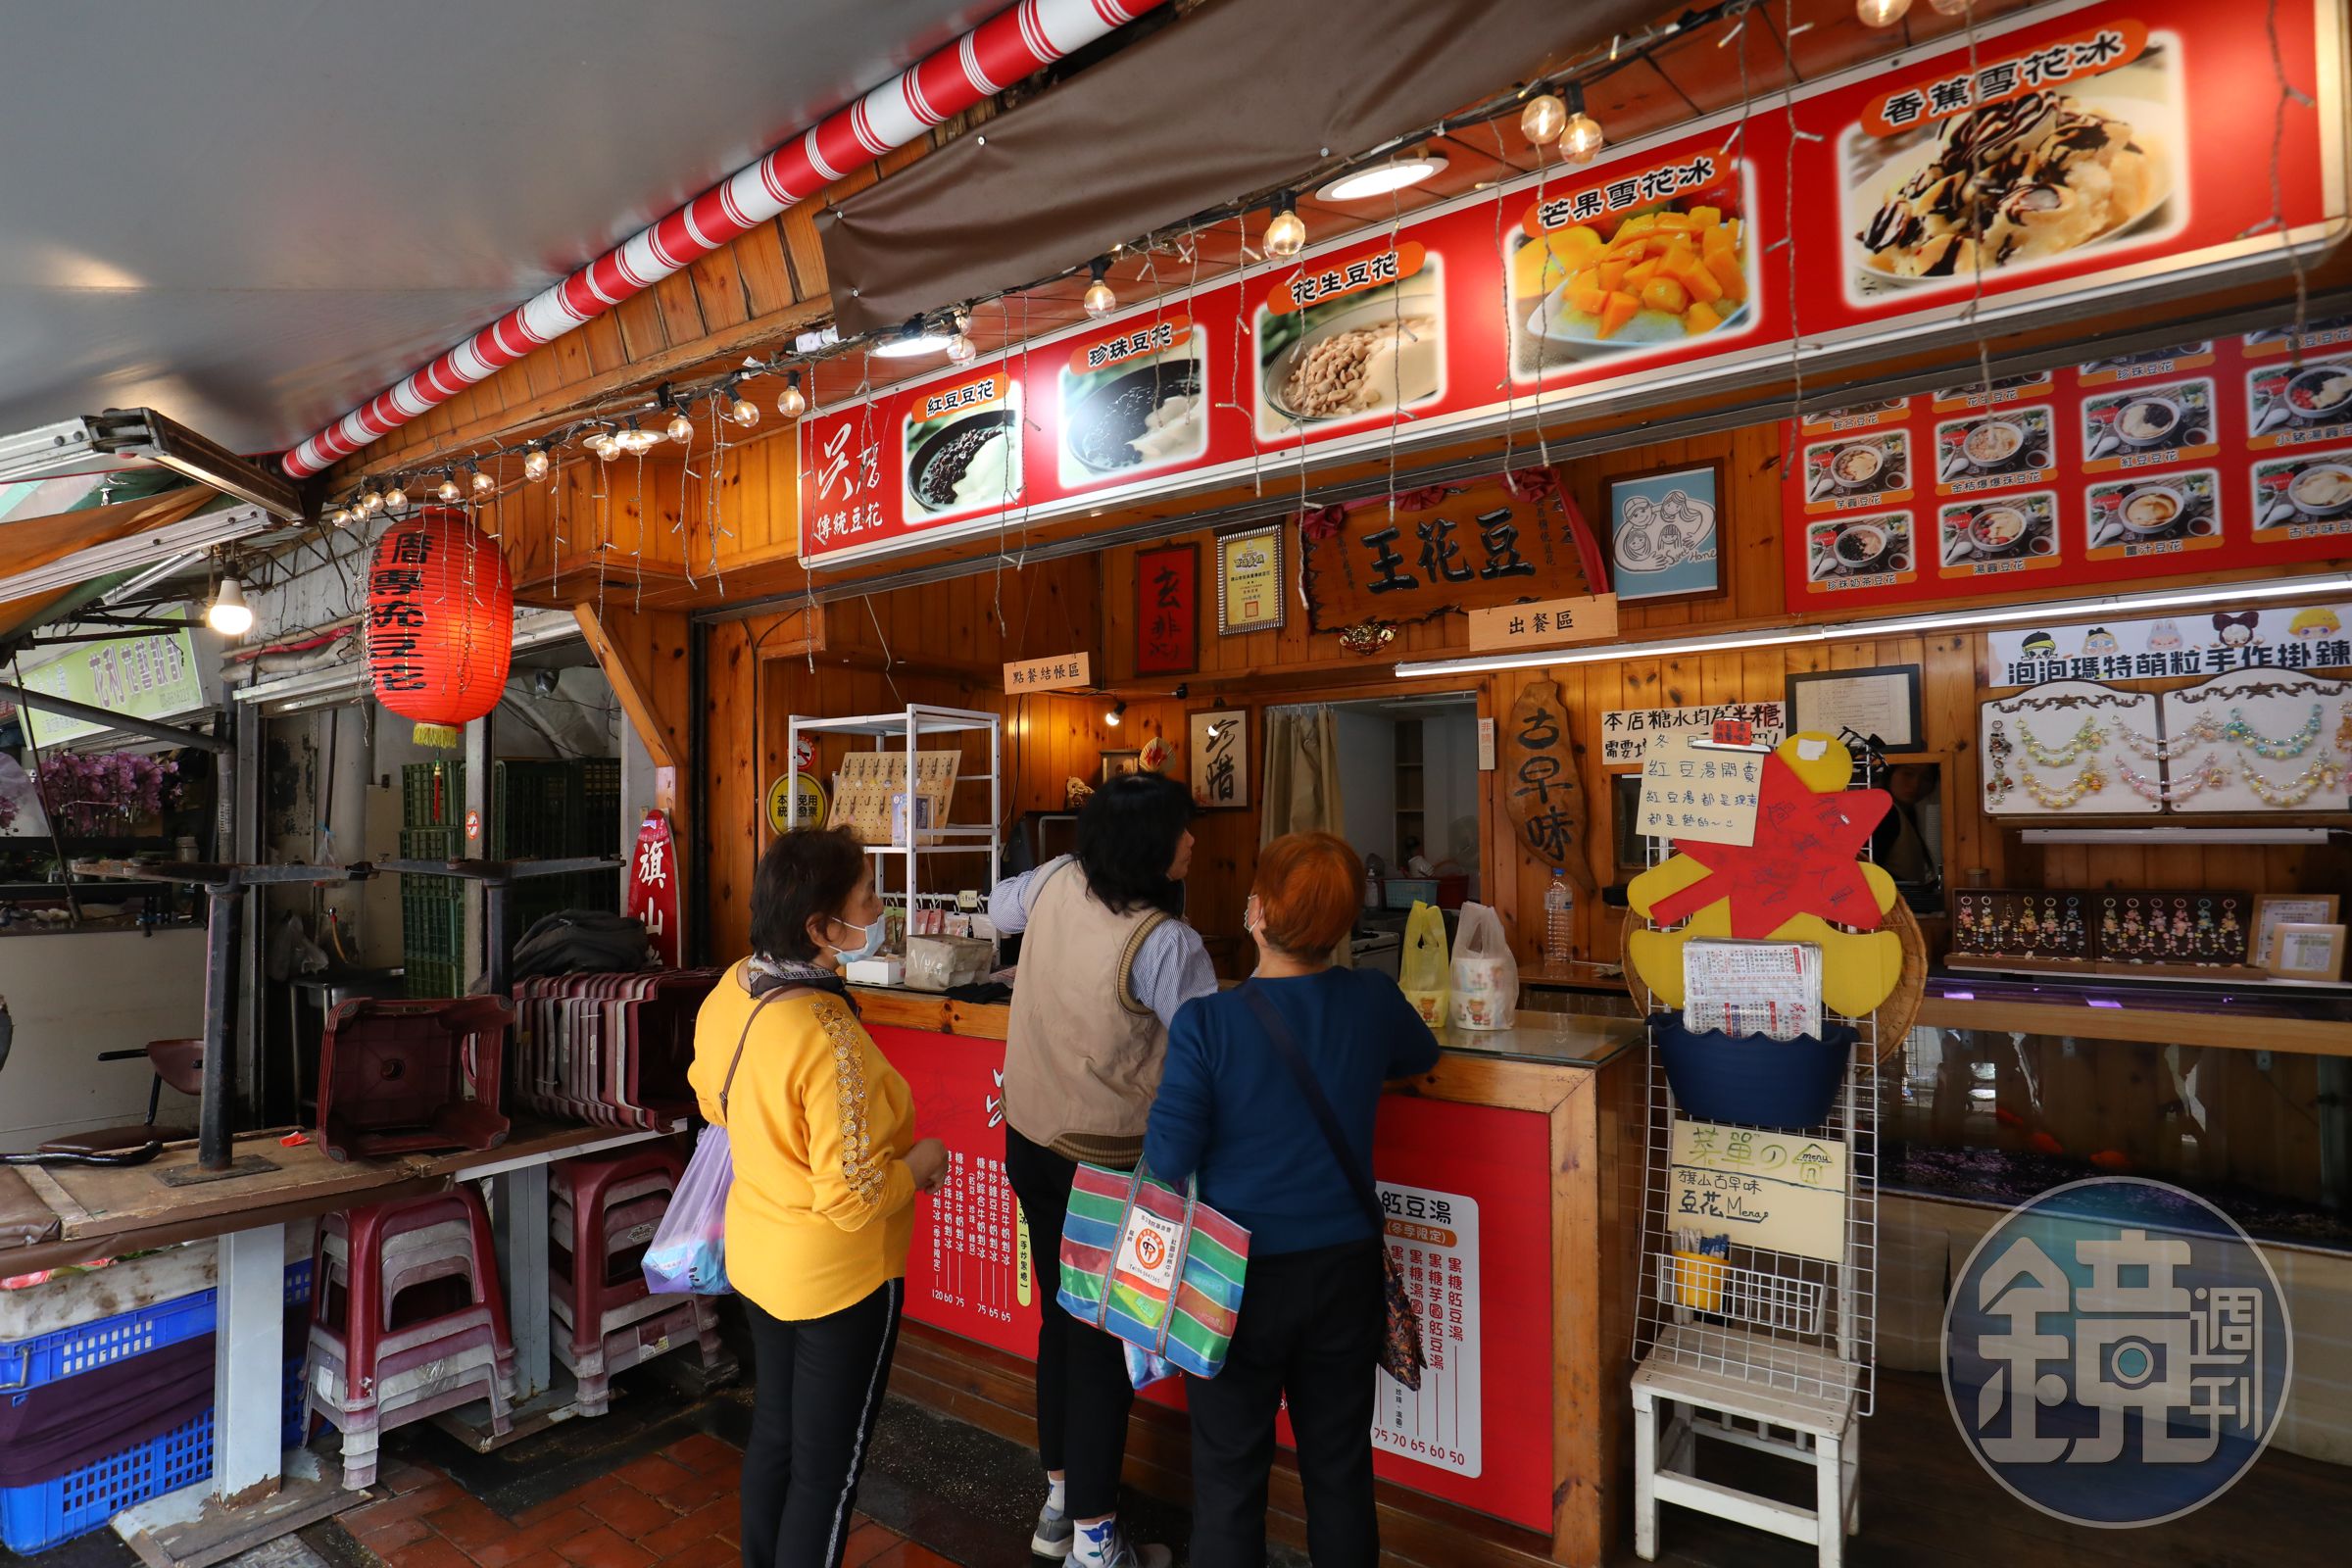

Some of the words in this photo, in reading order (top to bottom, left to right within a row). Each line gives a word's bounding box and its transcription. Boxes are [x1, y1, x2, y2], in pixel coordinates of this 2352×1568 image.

[1883, 31, 2123, 126] 香蕉雪花冰
[1538, 156, 1715, 229] 芒果雪花冰
[1293, 253, 1398, 306] 花生豆花
[1089, 322, 1173, 368] 珍珠豆花
[2117, 361, 2174, 380] 珍珠豆花
[926, 379, 995, 416] 紅豆豆花
[1967, 389, 2017, 408] 花生豆花
[1833, 414, 1879, 432] 綜合豆花
[2121, 450, 2179, 468] 紅豆豆花
[1951, 470, 2042, 494] 金桔爆爆珠豆花
[1835, 495, 1882, 510] 芋圓豆花
[817, 502, 883, 539] 傳統豆花
[2125, 540, 2182, 557] 薑汁豆花
[1974, 561, 2025, 575] 湯圓豆花
[1827, 574, 1896, 591] 珍珠奶茶豆花
[1509, 610, 1574, 635] 出餐區
[2008, 640, 2351, 686] 泡泡瑪特萌粒手作掛鍊
[1012, 662, 1080, 685] 點餐結帳區
[1647, 759, 1758, 783] 紅豆湯開賣
[1514, 708, 1574, 862] 古早味
[777, 794, 818, 807] 本免用
[777, 806, 818, 818] 統發票
[1801, 1152, 1829, 1162] menu
[1678, 1169, 1762, 1196] 旗山古早味
[1382, 1190, 1451, 1225] 紅豆湯
[1678, 1190, 1724, 1218] 豆花
[1387, 1223, 1446, 1245] (冬季限定)
[932, 1289, 944, 1300] 120
[944, 1294, 954, 1304] 60
[956, 1296, 964, 1307] 75
[1447, 1257, 1463, 1342] 黑糖紅豆湯
[977, 1302, 987, 1314] 75
[989, 1308, 999, 1318] 65
[1001, 1311, 1010, 1322] 65
[1428, 1253, 1444, 1370] 黑糖芋圓紅豆湯
[1374, 1427, 1389, 1442] 75
[1392, 1433, 1406, 1447] 70
[1410, 1439, 1426, 1453] 65
[1430, 1445, 1445, 1459] 60
[1449, 1450, 1465, 1466] 50
